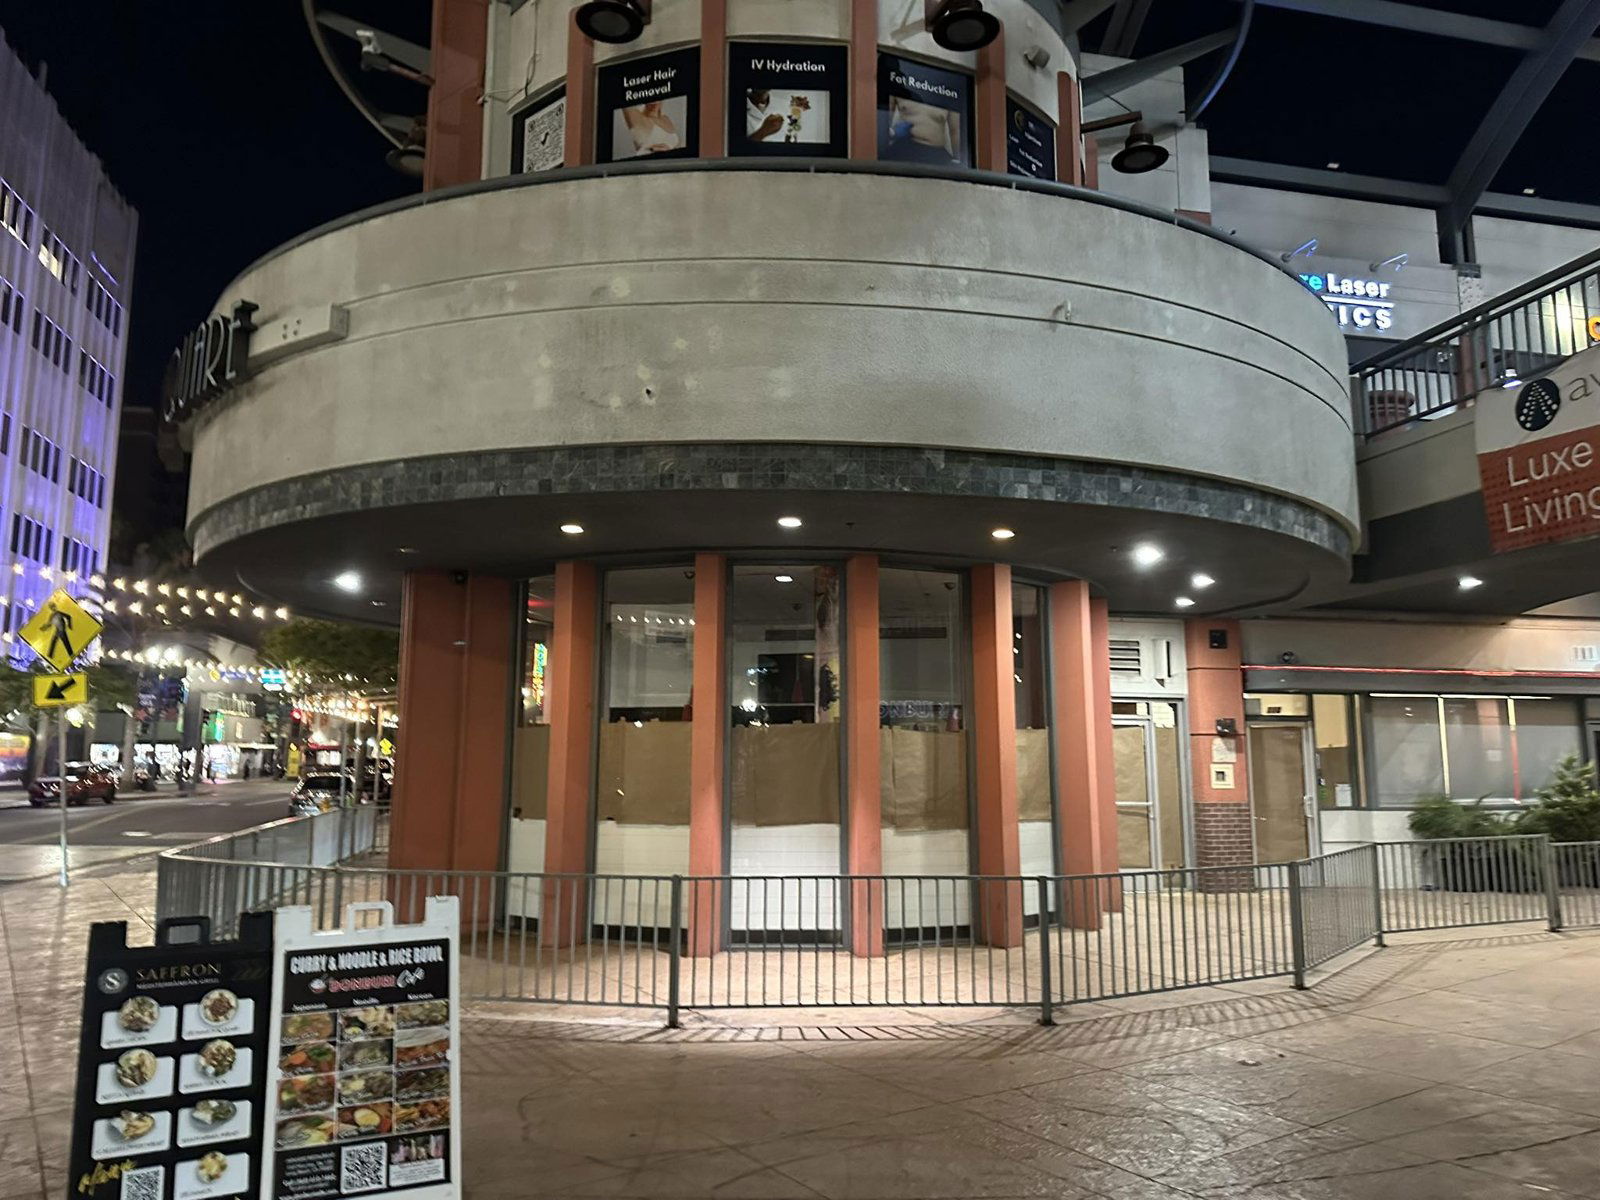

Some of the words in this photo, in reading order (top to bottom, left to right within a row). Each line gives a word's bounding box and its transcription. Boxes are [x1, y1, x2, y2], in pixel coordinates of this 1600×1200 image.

[751, 59, 764, 70] IV
[766, 59, 826, 73] Hydration
[623, 74, 652, 87] Laser
[653, 67, 677, 80] Hair
[889, 71, 907, 87] Fat
[908, 76, 958, 99] Reduction
[625, 80, 671, 101] Removal
[1326, 272, 1391, 299] Laser
[1507, 441, 1594, 488] Luxe
[135, 962, 222, 981] SAFFRON
